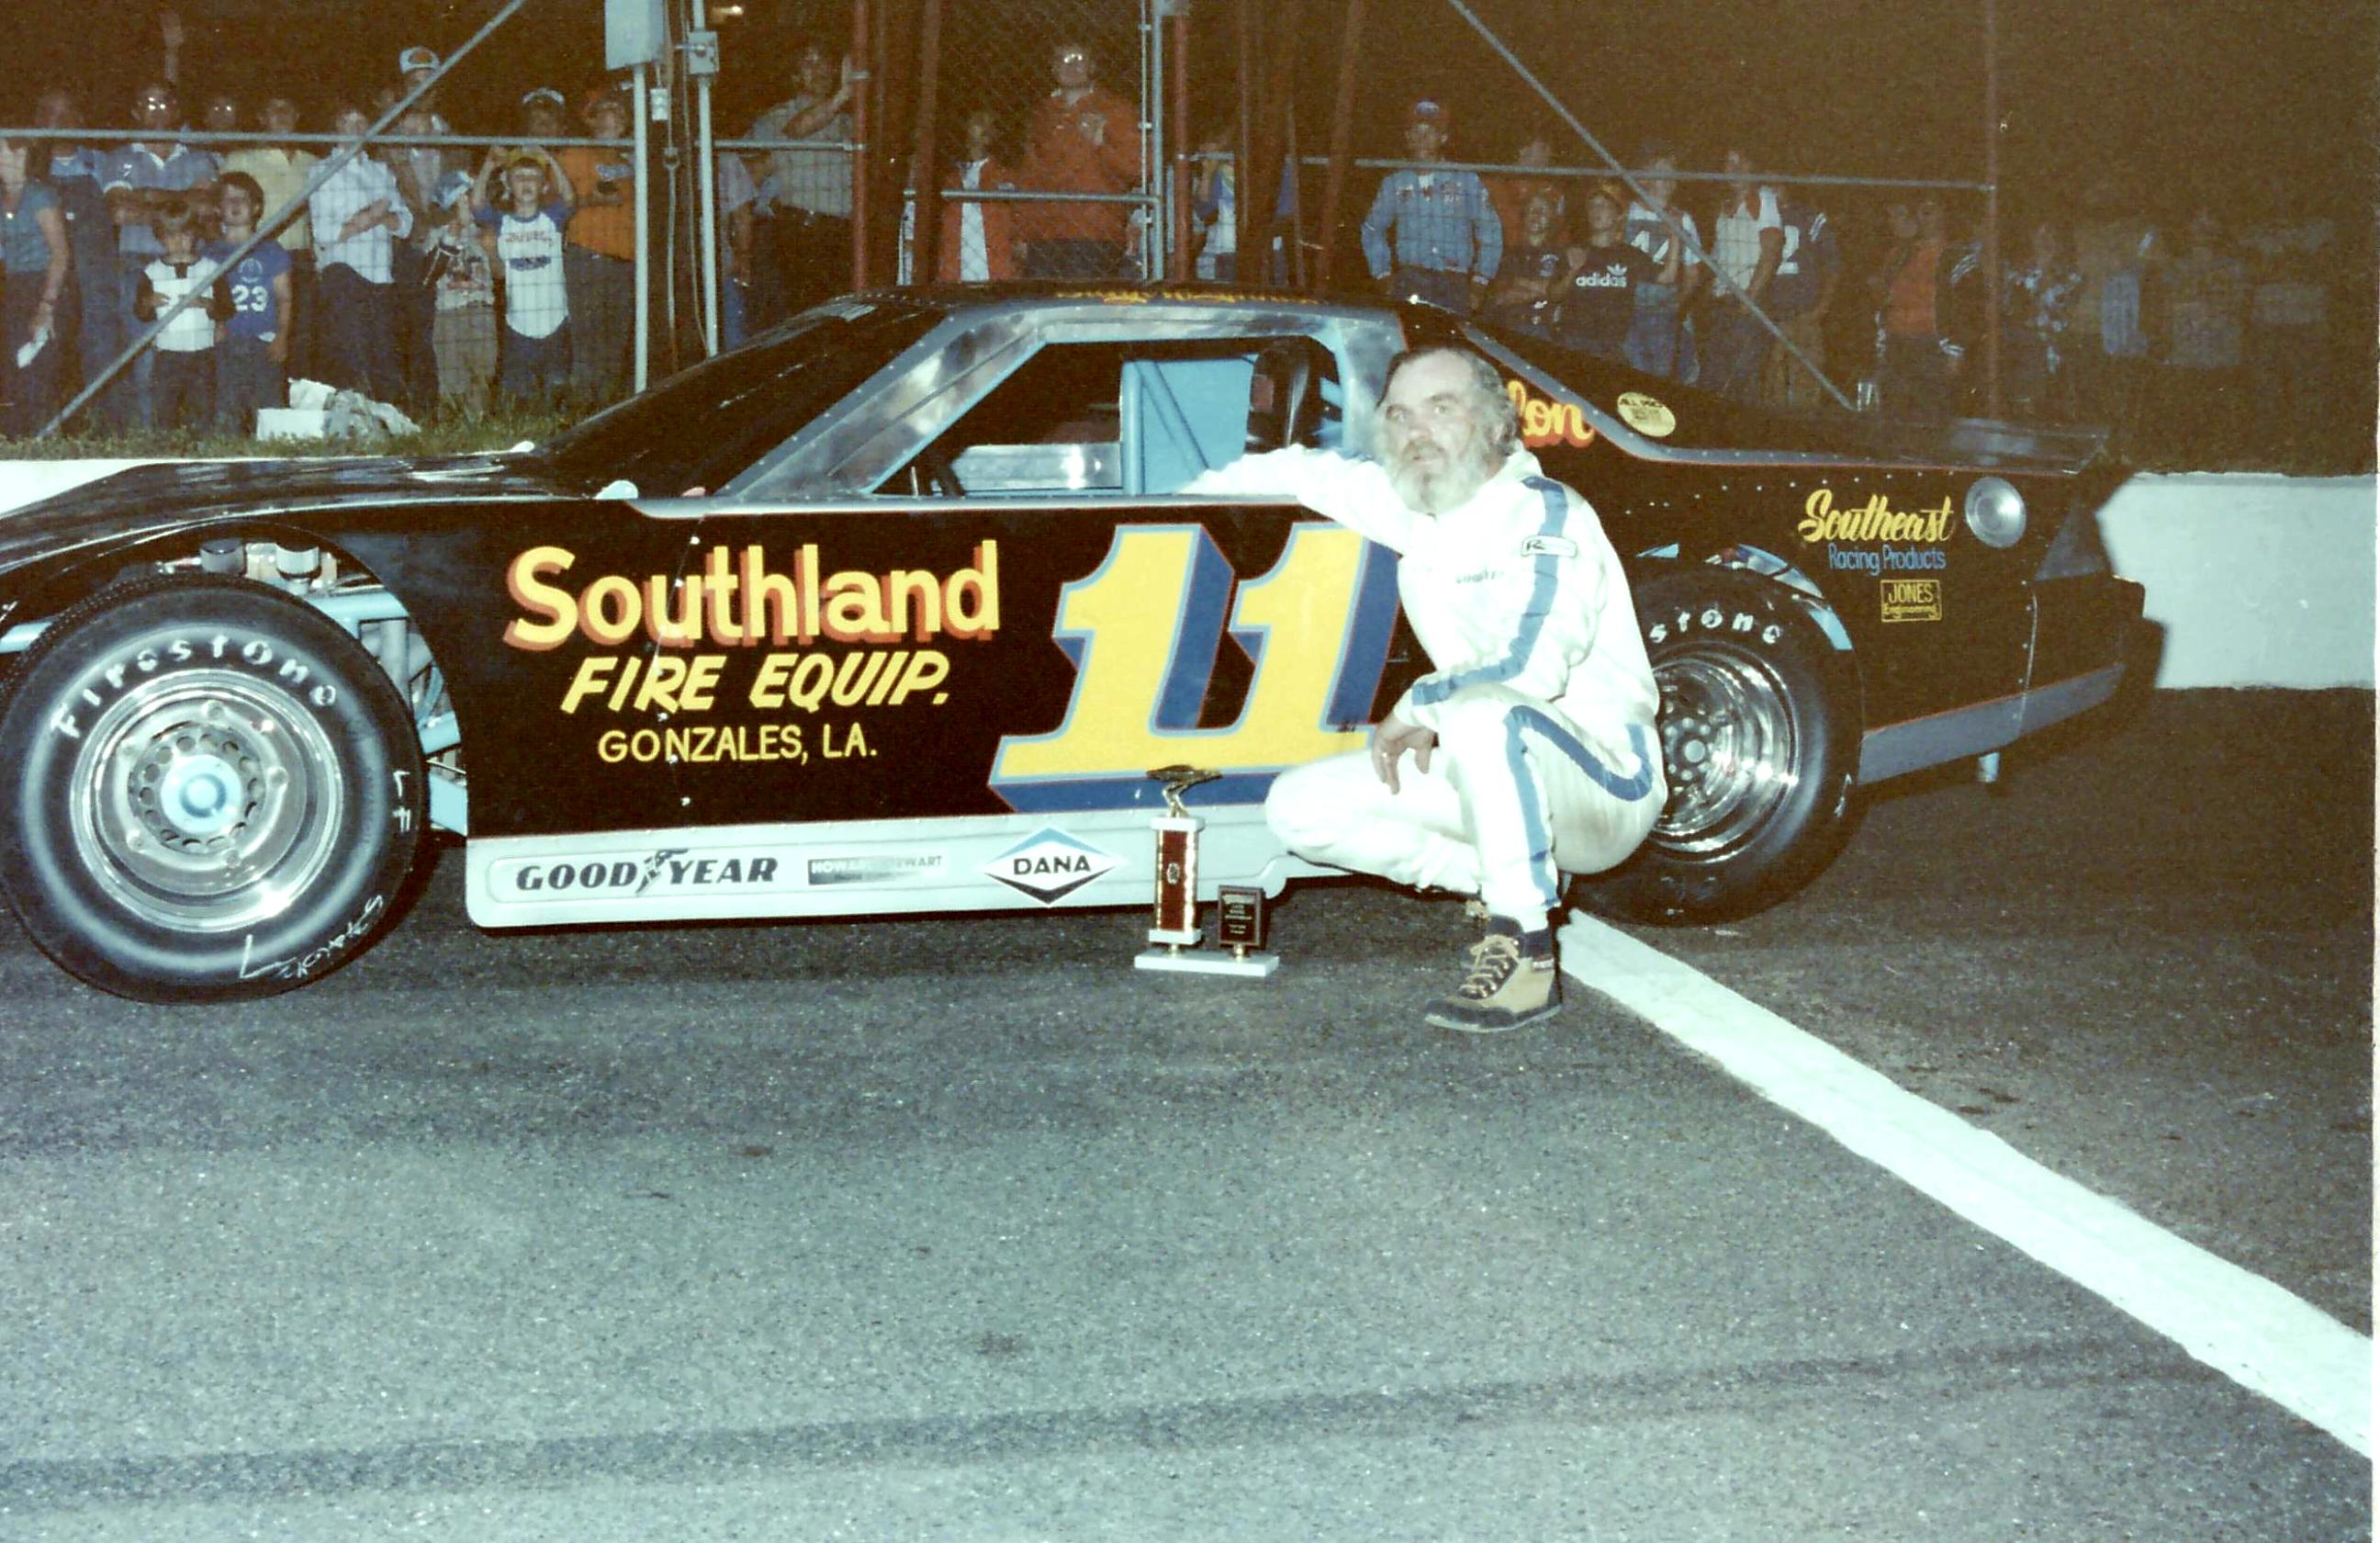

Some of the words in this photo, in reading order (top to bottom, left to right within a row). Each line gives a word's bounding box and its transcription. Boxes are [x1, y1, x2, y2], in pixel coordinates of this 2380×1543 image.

[231, 285, 268, 312] 23
[1576, 272, 1627, 287] adidas
[1798, 489, 1954, 542] Southeast
[1828, 543, 1880, 576] Racing
[1882, 544, 1946, 569] Products
[503, 539, 1001, 651] Southland
[1888, 583, 1933, 603] JONES
[560, 653, 727, 715] FIRE
[748, 650, 951, 714] EQUIP.
[989, 522, 1391, 806] 11
[51, 635, 337, 738] Firestone
[598, 725, 808, 766] GONZALES,
[823, 723, 878, 759] LA.
[1013, 854, 1092, 877] DANA
